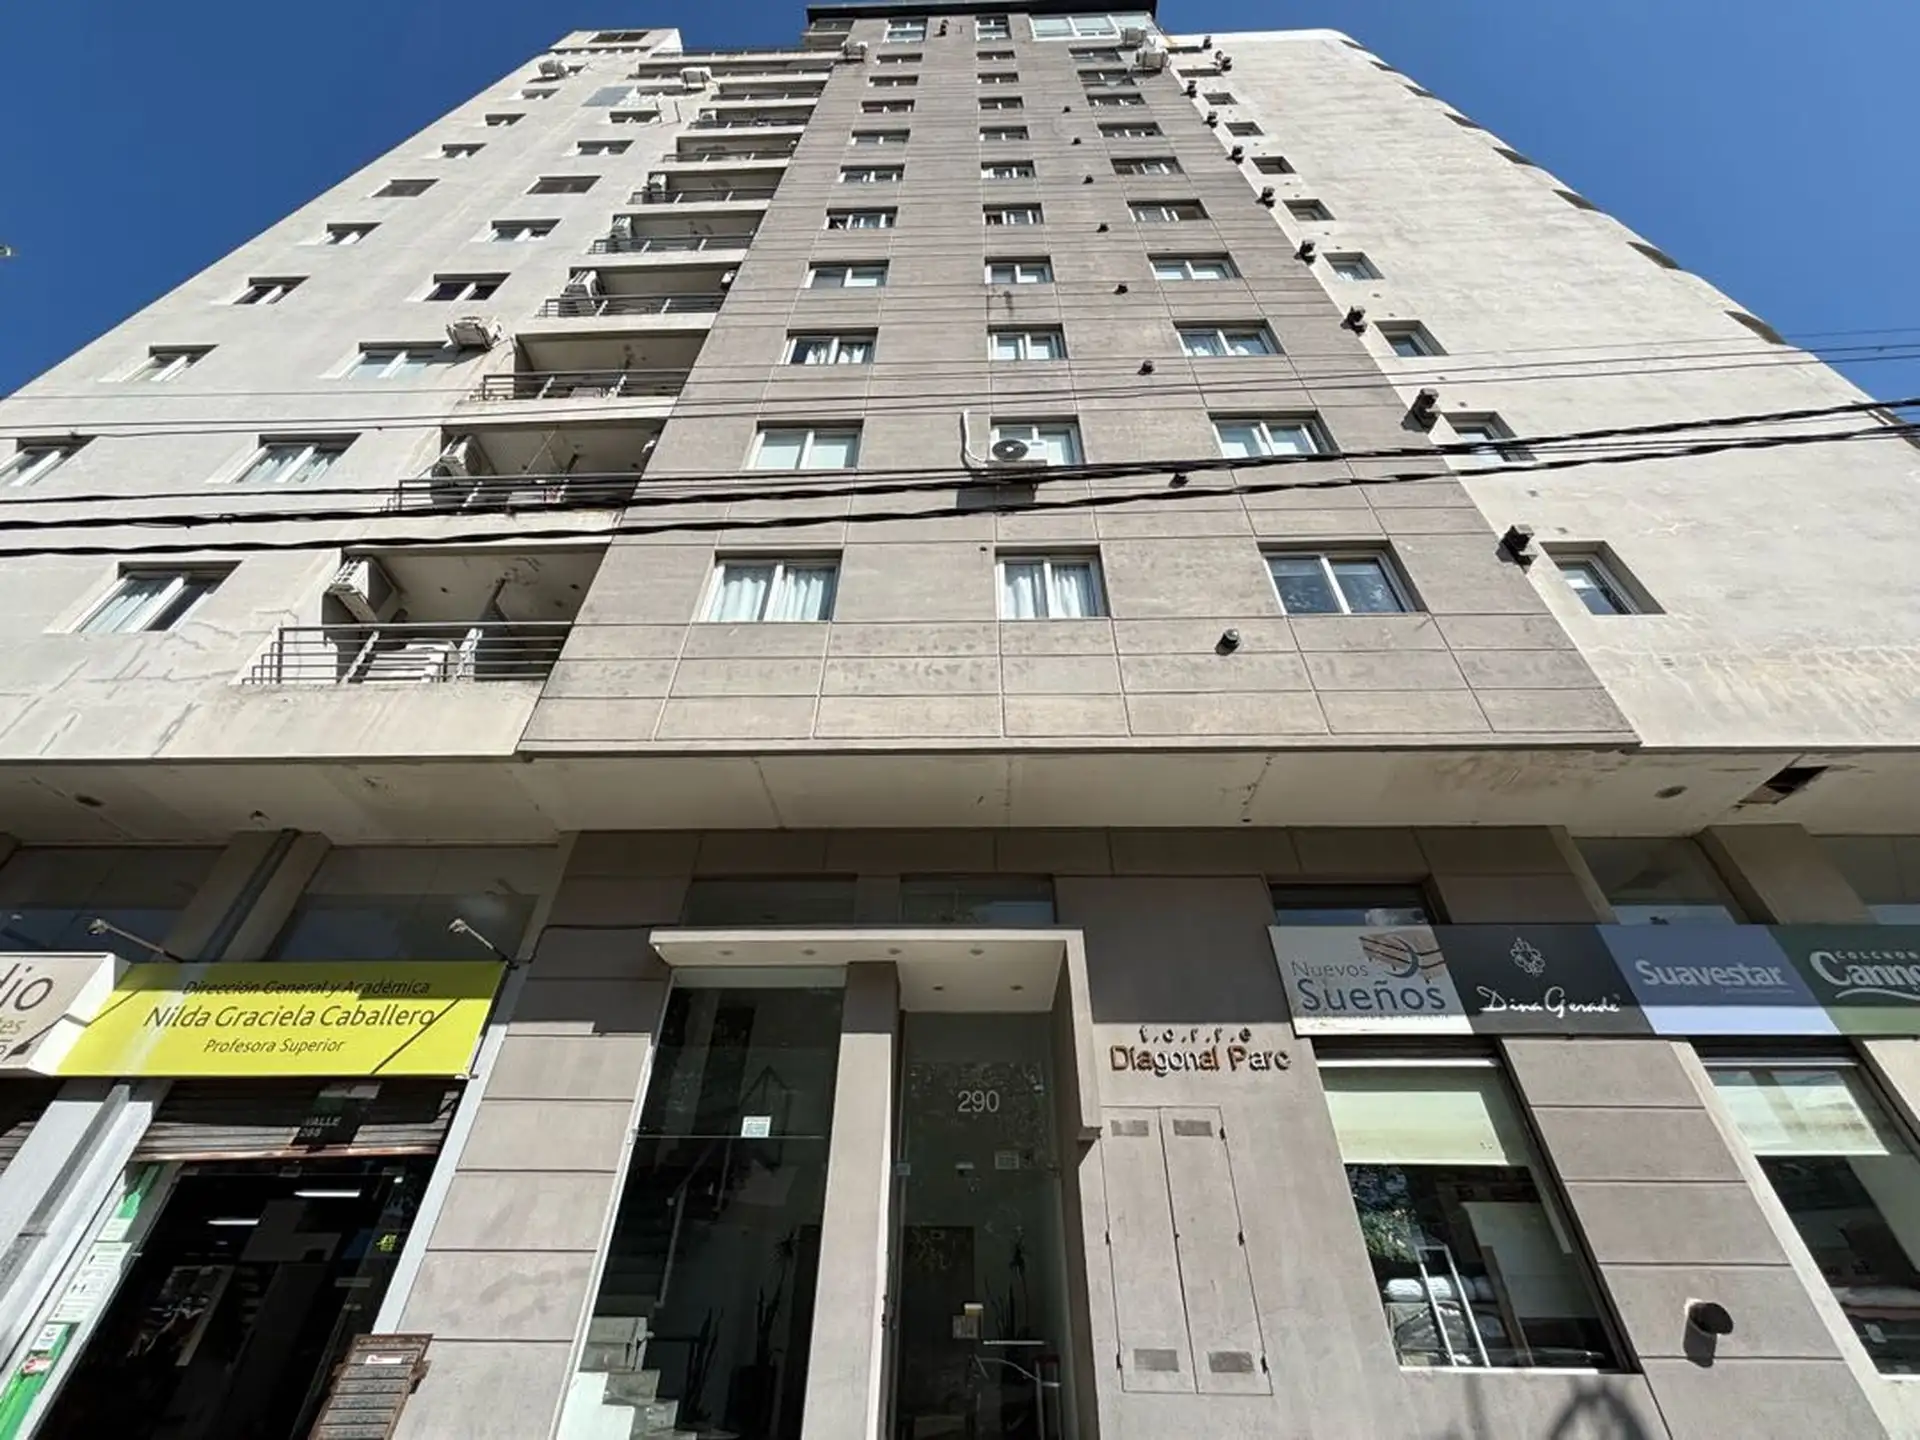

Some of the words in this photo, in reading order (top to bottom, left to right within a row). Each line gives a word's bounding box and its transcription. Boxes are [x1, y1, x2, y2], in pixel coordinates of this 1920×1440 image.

[1292, 961, 1369, 977] Nuevos
[1635, 959, 1790, 986] Suavestar
[264, 980, 326, 994] General
[1297, 979, 1446, 1011] Sueños
[1476, 986, 1543, 1012] Dina
[143, 1004, 211, 1027] Nilda
[215, 1004, 315, 1027] Graciela
[320, 1004, 435, 1026] Caballero
[203, 1038, 276, 1053] Profesora
[279, 1038, 345, 1056] Superior
[1110, 1045, 1219, 1077] Diagonal
[1227, 1045, 1291, 1071] Parc
[957, 1090, 1000, 1112] 290
